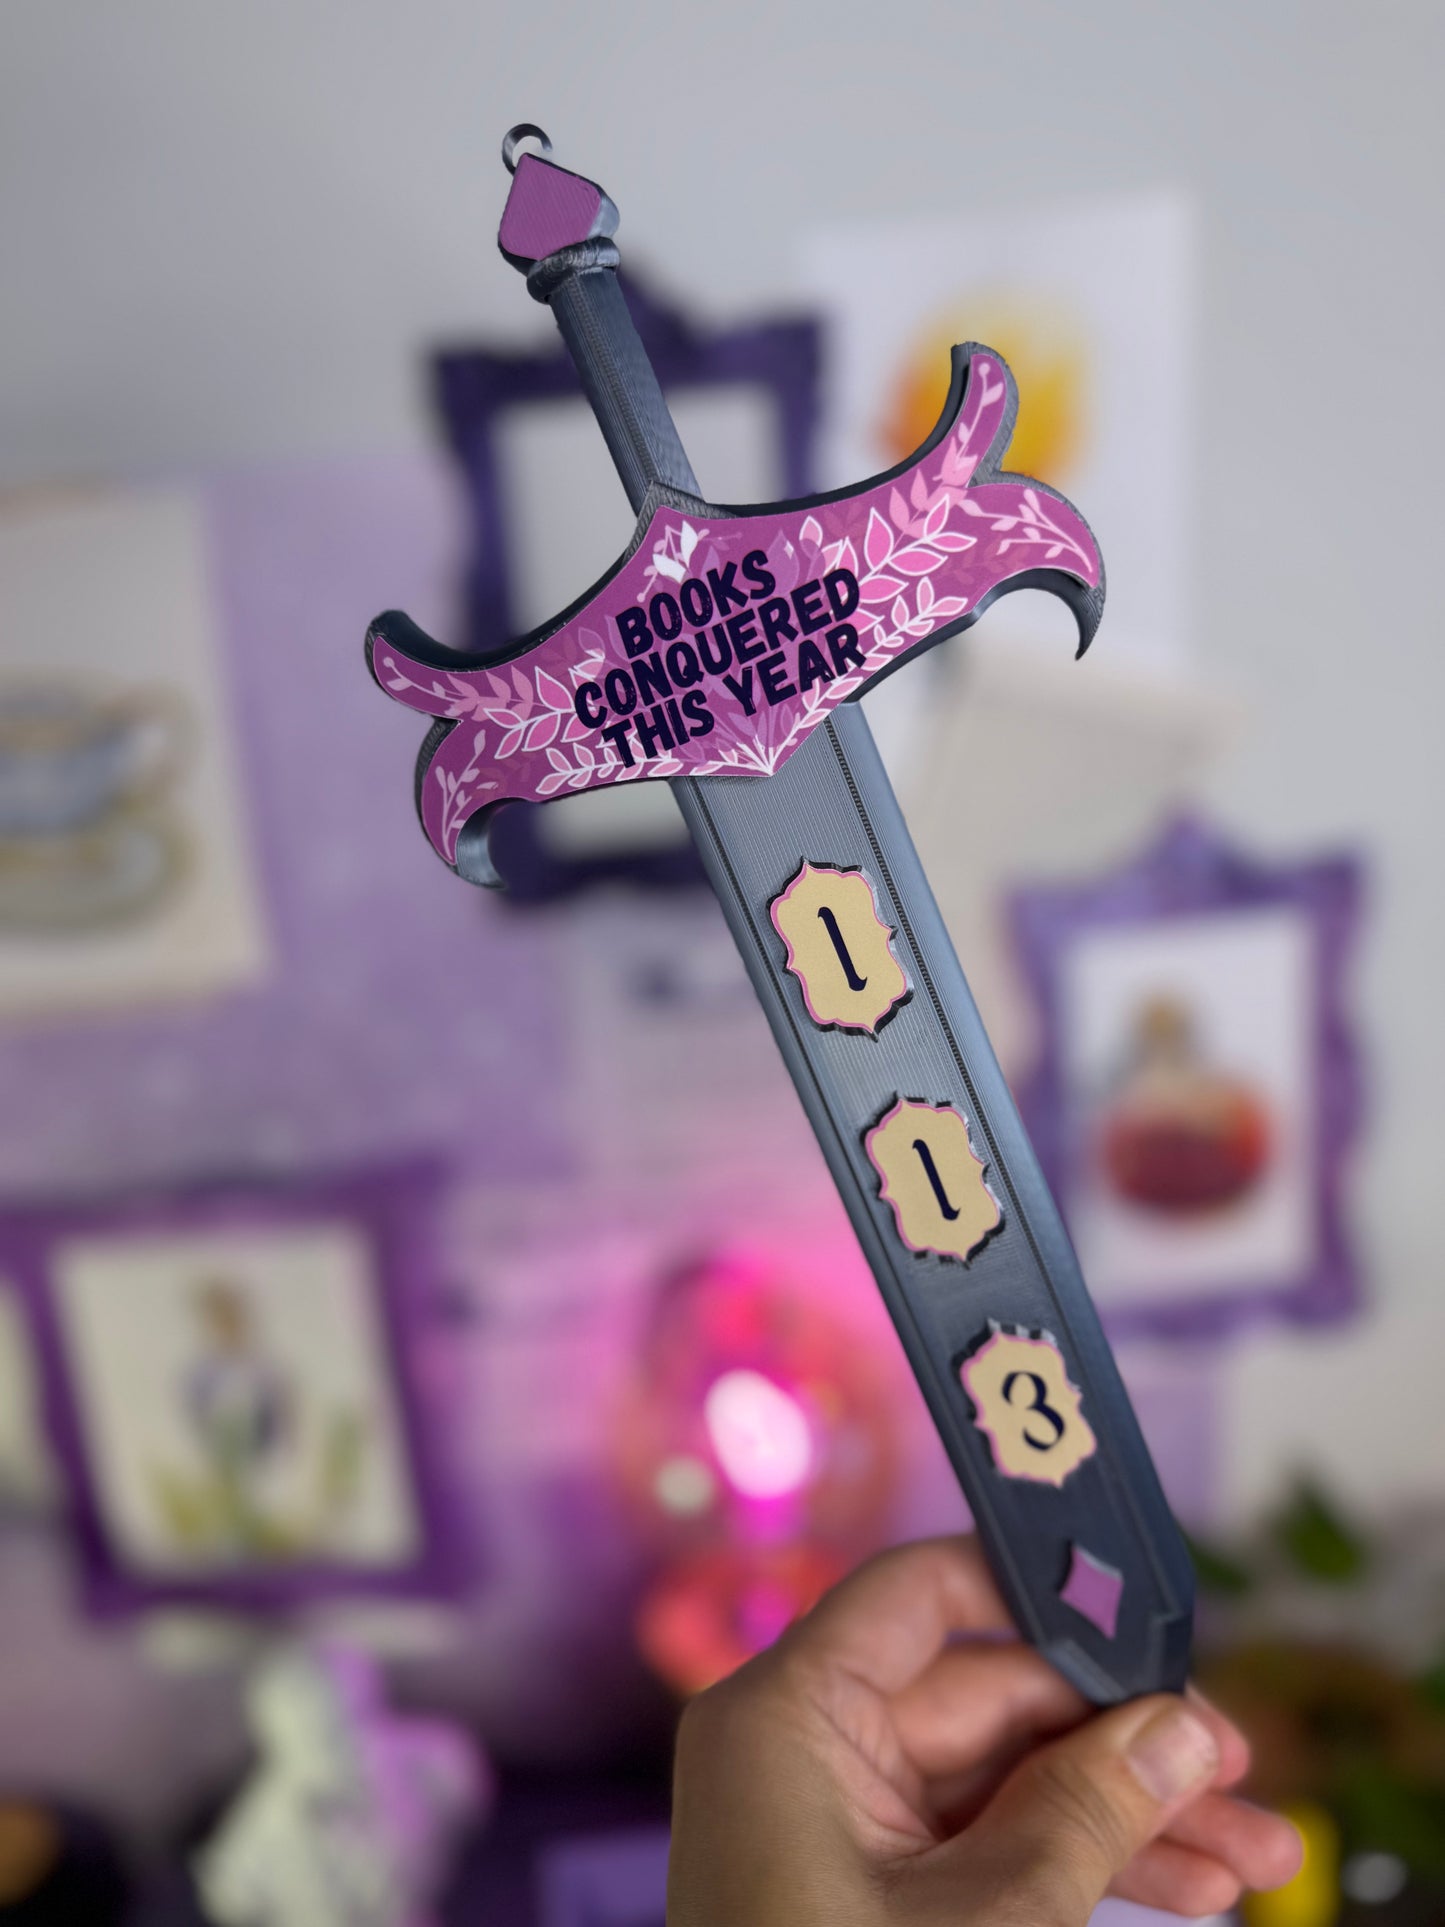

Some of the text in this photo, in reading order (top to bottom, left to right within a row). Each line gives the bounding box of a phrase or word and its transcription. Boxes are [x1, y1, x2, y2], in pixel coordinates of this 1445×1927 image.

[573, 568, 860, 729] CONQUERED
[615, 549, 776, 659] BOOKS
[600, 623, 867, 769] THIS YEAR
[817, 906, 868, 992] 1
[912, 1139, 961, 1221] 1
[1002, 1371, 1066, 1452] 3
